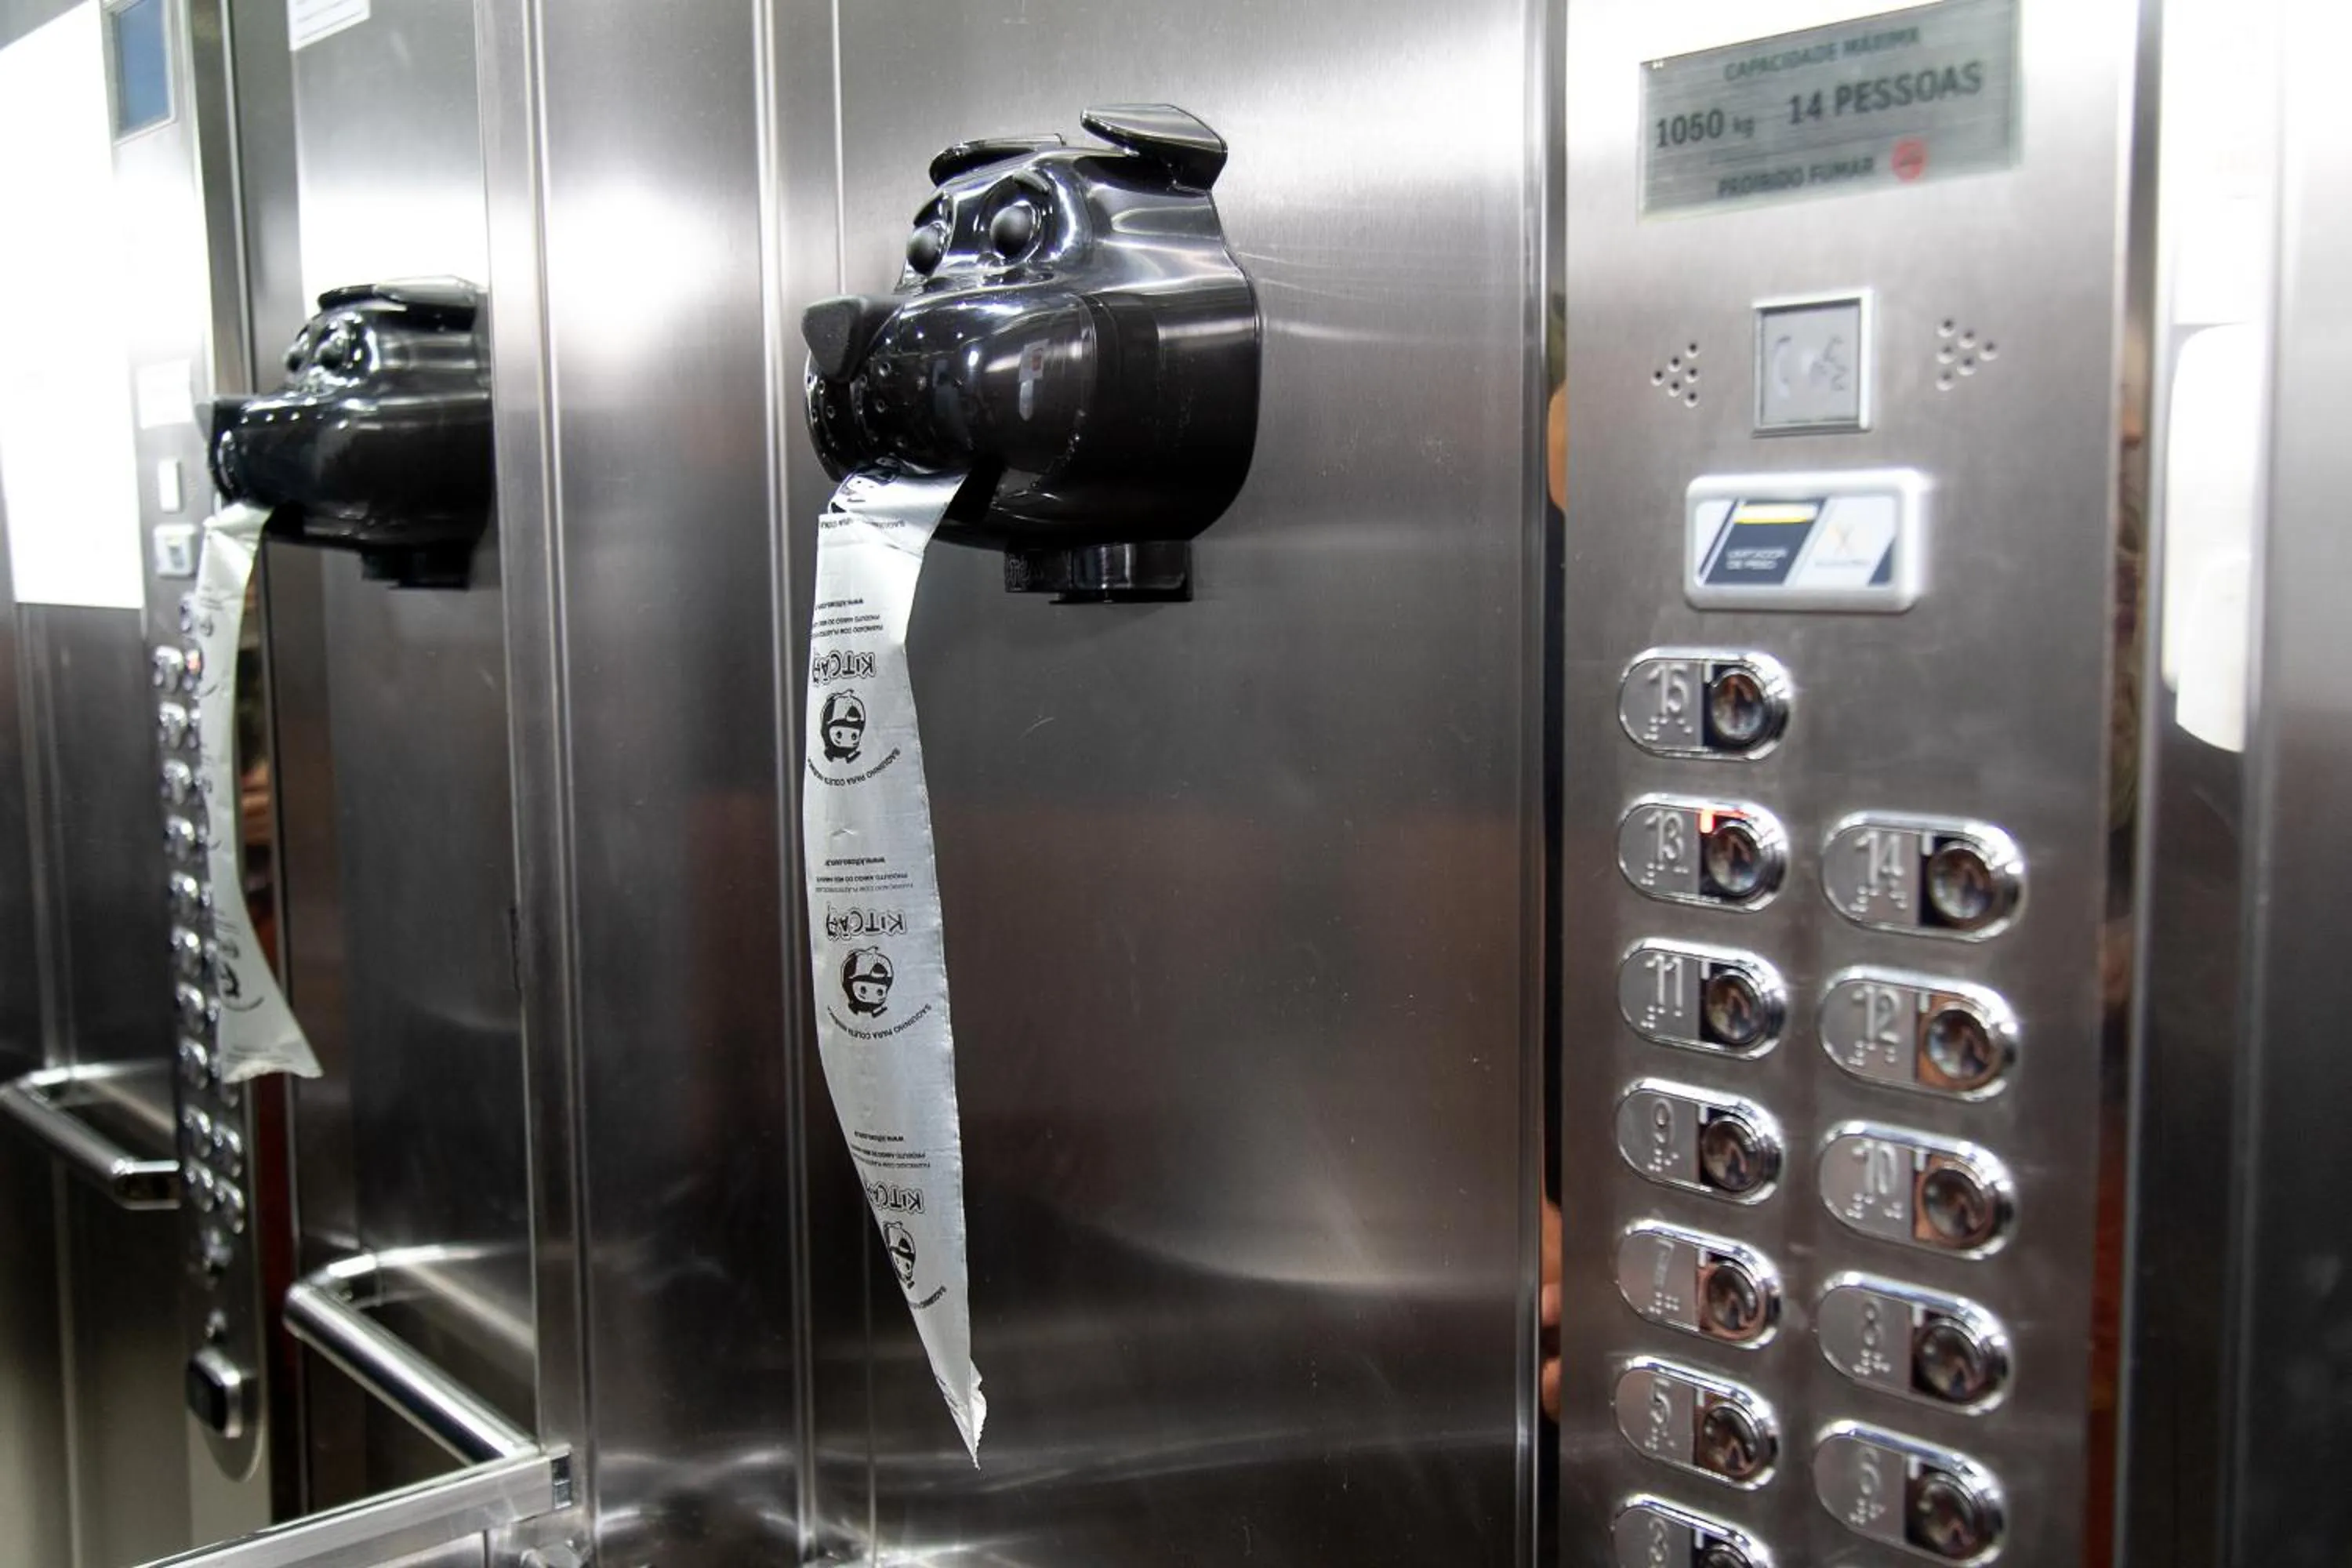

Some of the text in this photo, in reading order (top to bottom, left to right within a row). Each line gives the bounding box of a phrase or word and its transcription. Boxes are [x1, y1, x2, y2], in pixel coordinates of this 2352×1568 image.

[1656, 108, 1724, 148] 1050
[1789, 93, 1822, 124] 14
[1835, 61, 1983, 117] PESSOAS
[1649, 663, 1690, 715] 15
[1646, 811, 1683, 864] 13
[1854, 830, 1904, 891] 14
[1646, 954, 1683, 1010] 11
[1853, 985, 1900, 1044] 12
[1650, 1098, 1675, 1145] 9
[1852, 1138, 1897, 1194] 10
[1653, 1239, 1675, 1287] 7
[1863, 1298, 1880, 1344] 8
